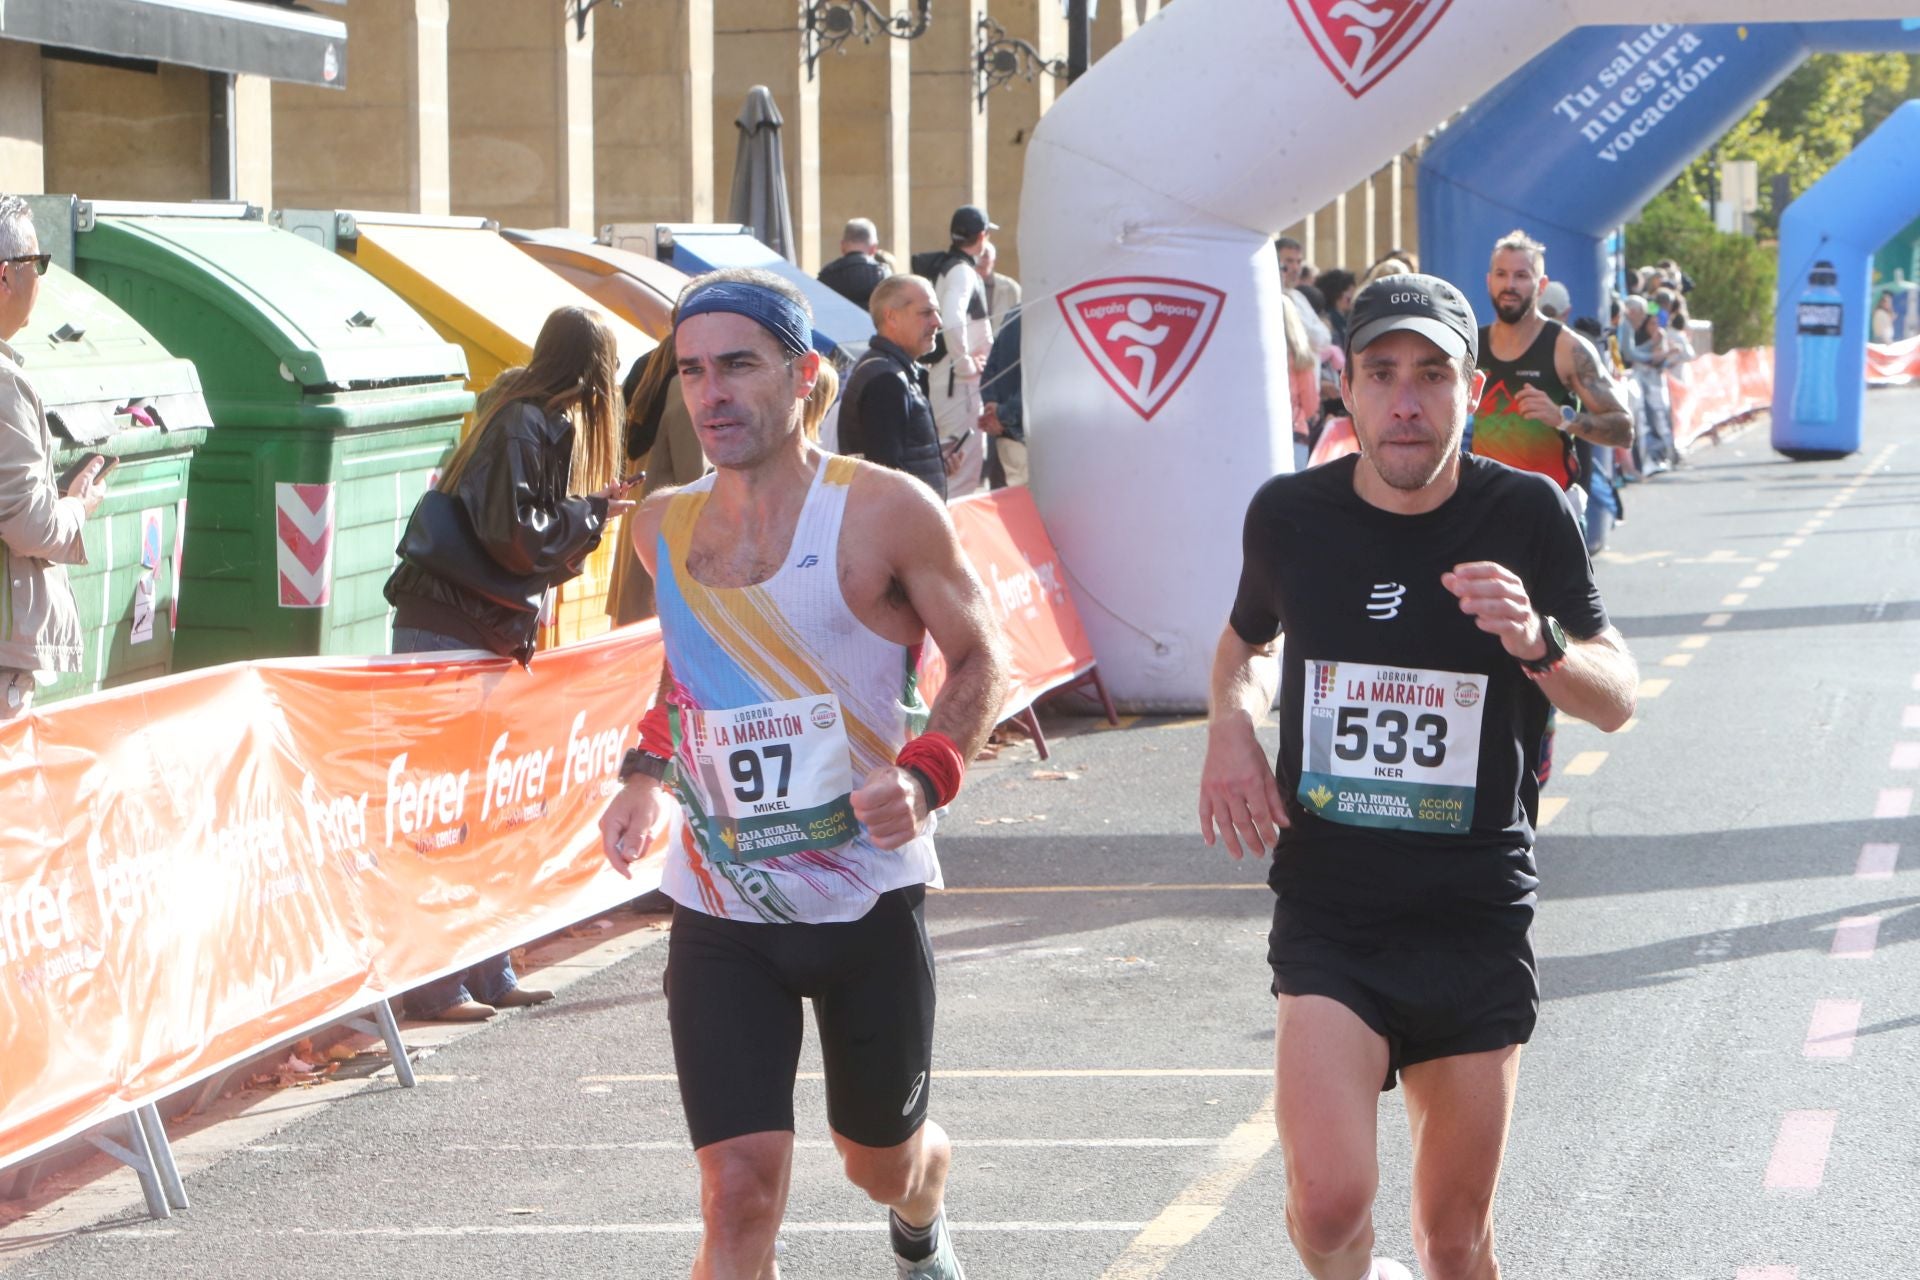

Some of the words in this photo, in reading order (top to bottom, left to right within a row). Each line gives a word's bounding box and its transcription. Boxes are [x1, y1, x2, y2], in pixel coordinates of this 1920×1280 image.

[1580, 32, 1702, 143] nuestra
[1553, 85, 1601, 121] Tu
[1597, 55, 1725, 162] vocación.
[1391, 292, 1429, 306] GORE
[1084, 303, 1125, 319] Logroño
[1153, 302, 1198, 318] deporte
[1377, 671, 1418, 683] LOGROÑO
[1347, 680, 1365, 701] LA
[1371, 682, 1445, 708] MARATÓN
[734, 707, 774, 723] LOGROÑO
[1312, 708, 1333, 718] 42K
[714, 727, 730, 746] LA
[732, 713, 803, 744] MARATÓN
[1335, 706, 1448, 768] 533
[560, 710, 629, 796] ferrer
[481, 731, 554, 821] ferrer
[729, 743, 792, 802] 97
[1374, 767, 1403, 778] IKER
[385, 752, 470, 848] ferrer
[753, 800, 790, 814] MIKEL
[1338, 791, 1367, 804] CAJA
[1369, 794, 1409, 807] RURAL
[1419, 797, 1463, 810] ACCIÓN
[1337, 802, 1354, 813] DE
[1357, 802, 1414, 818] NAVARRA
[1418, 810, 1462, 822] SOCIAL
[808, 810, 846, 830] ACCIÓN
[736, 830, 762, 842] CAJA
[762, 824, 801, 838] RURAL
[810, 822, 848, 840] SOCIAL
[738, 841, 754, 851] DE
[756, 831, 808, 849] NAVARRA
